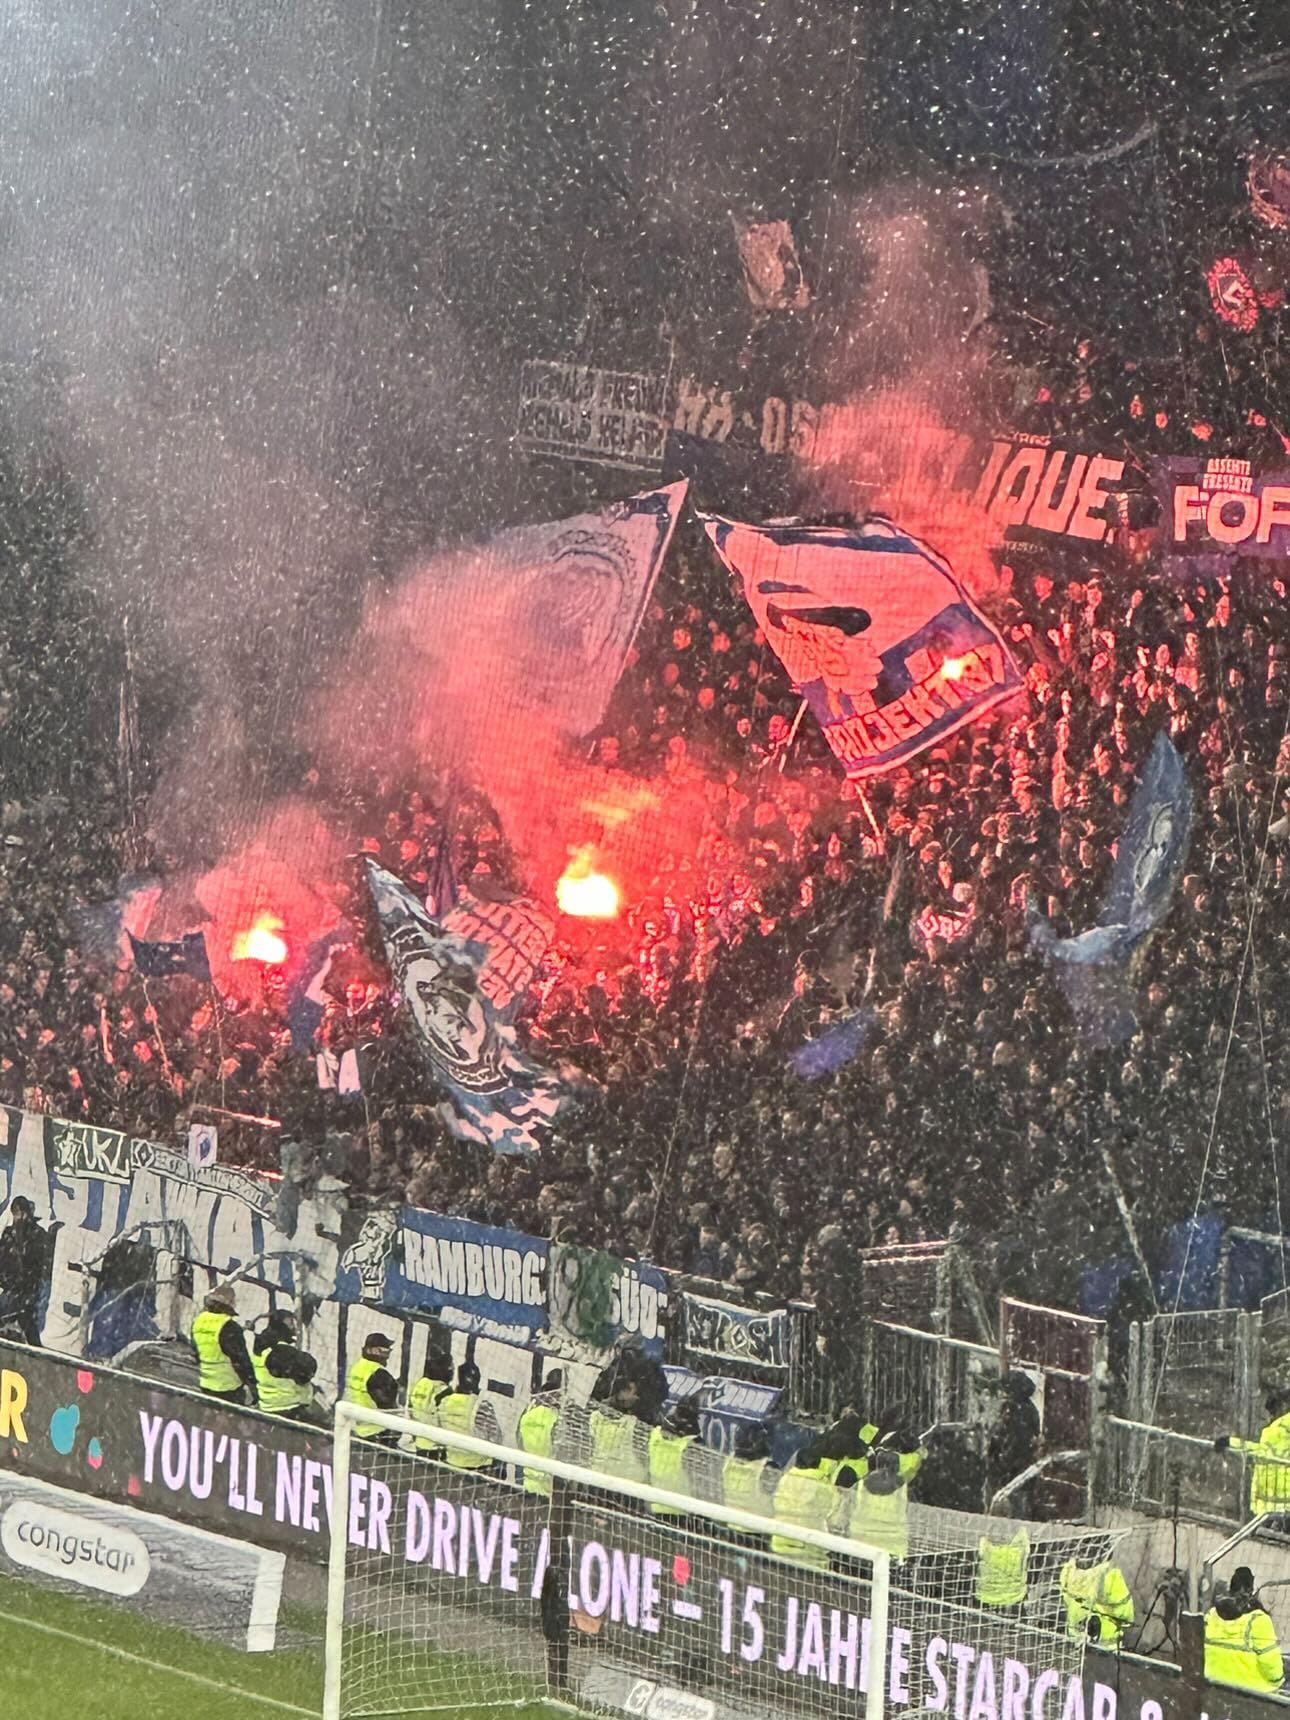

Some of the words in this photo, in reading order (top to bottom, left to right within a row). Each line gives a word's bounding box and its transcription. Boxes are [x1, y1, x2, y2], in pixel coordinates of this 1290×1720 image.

[950, 437, 1126, 541] IQUE
[17, 1520, 136, 1575] congstar
[406, 1489, 521, 1593] DRIVE
[718, 1579, 765, 1662] 15
[777, 1596, 911, 1704] JAHE
